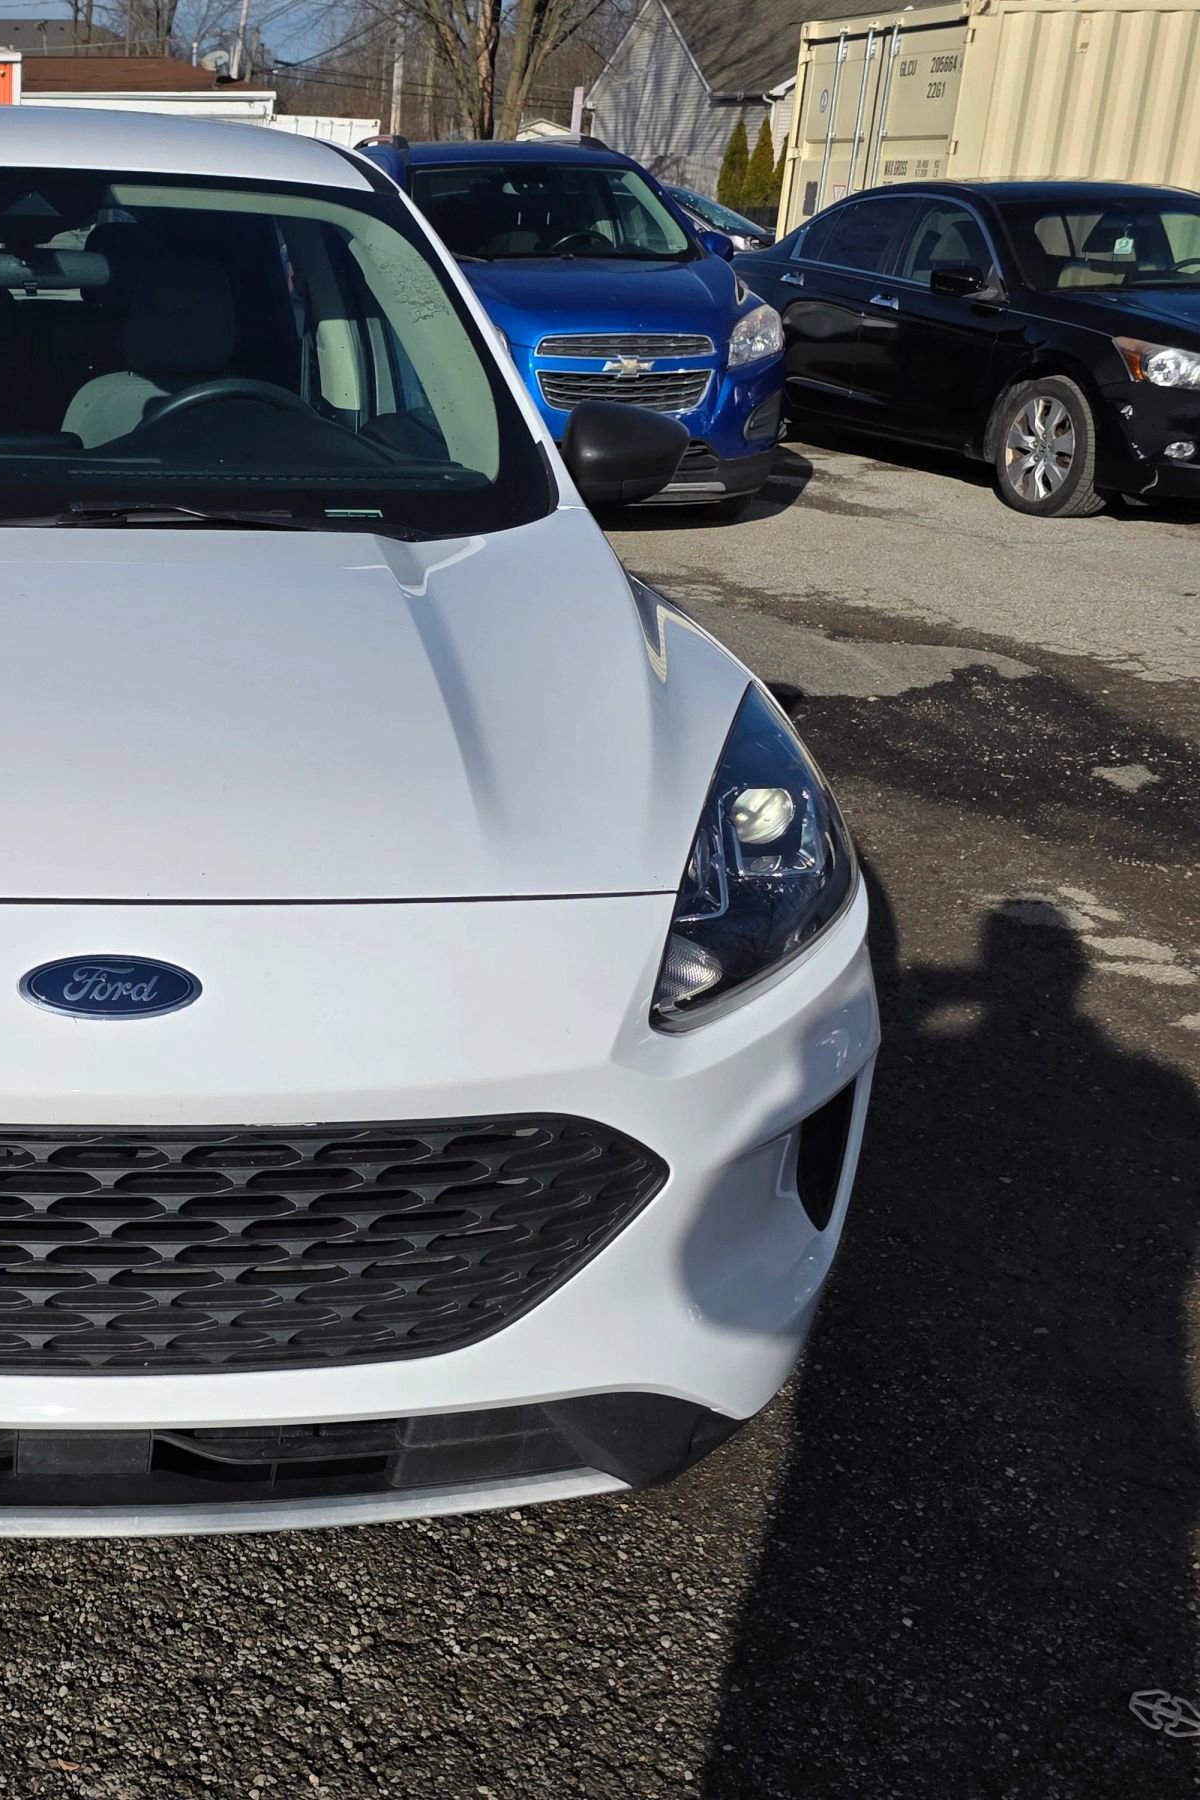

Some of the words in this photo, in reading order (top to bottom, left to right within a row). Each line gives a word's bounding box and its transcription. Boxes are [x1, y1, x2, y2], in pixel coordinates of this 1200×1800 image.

[930, 55, 958, 73] 205664
[926, 81, 945, 98] 22G1
[63, 965, 159, 1002] Ford
